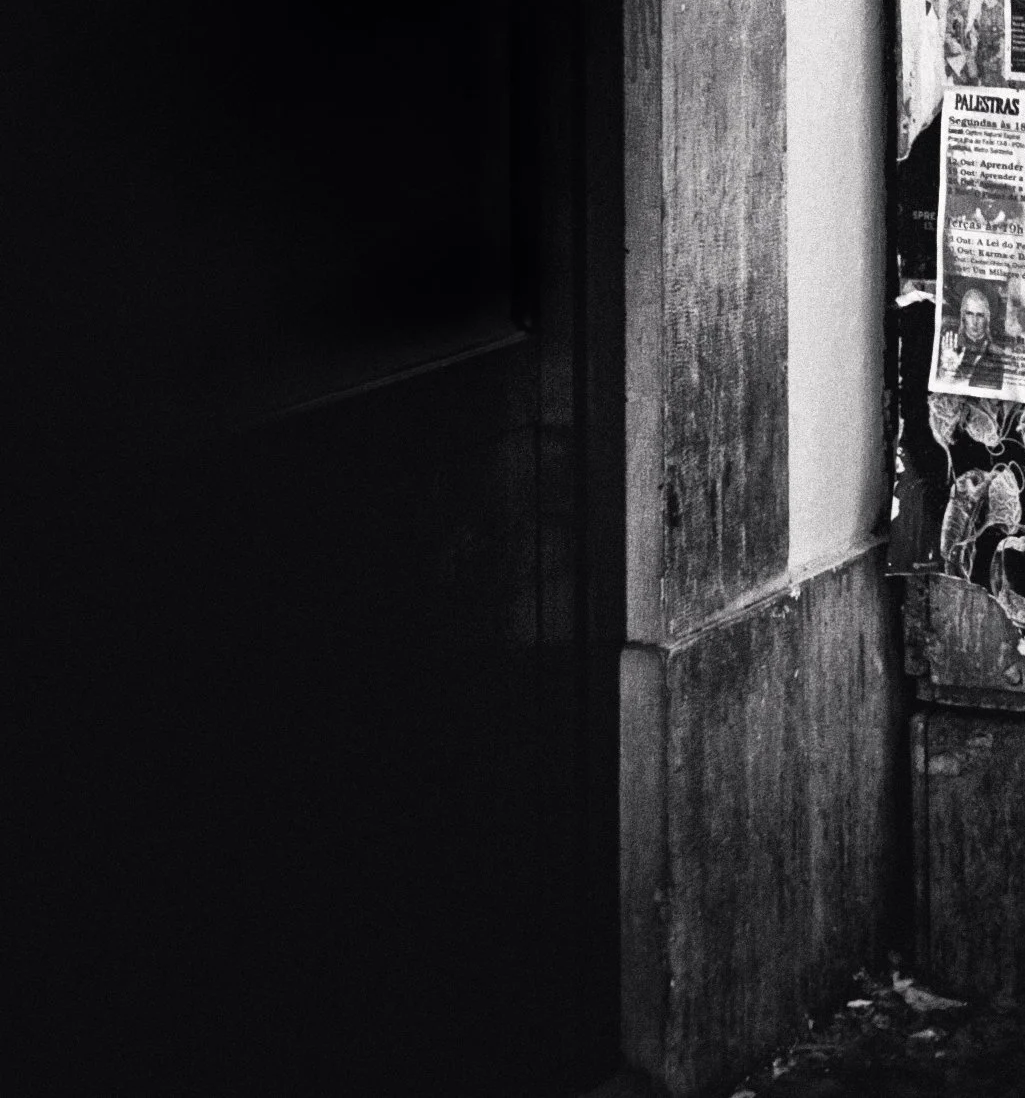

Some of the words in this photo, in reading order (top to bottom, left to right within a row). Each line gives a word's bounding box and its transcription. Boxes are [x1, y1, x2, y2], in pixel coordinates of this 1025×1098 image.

[955, 93, 1020, 116] PALESTRAS
[949, 116, 997, 128] Segundas
[1000, 120, 1011, 130] às
[980, 160, 1024, 170] Aprender
[980, 171, 1017, 181] Aprender
[977, 238, 984, 246] A
[986, 239, 999, 247] Lei
[1002, 240, 1014, 249] do
[978, 248, 1008, 259] Karma
[972, 267, 986, 275] Um
